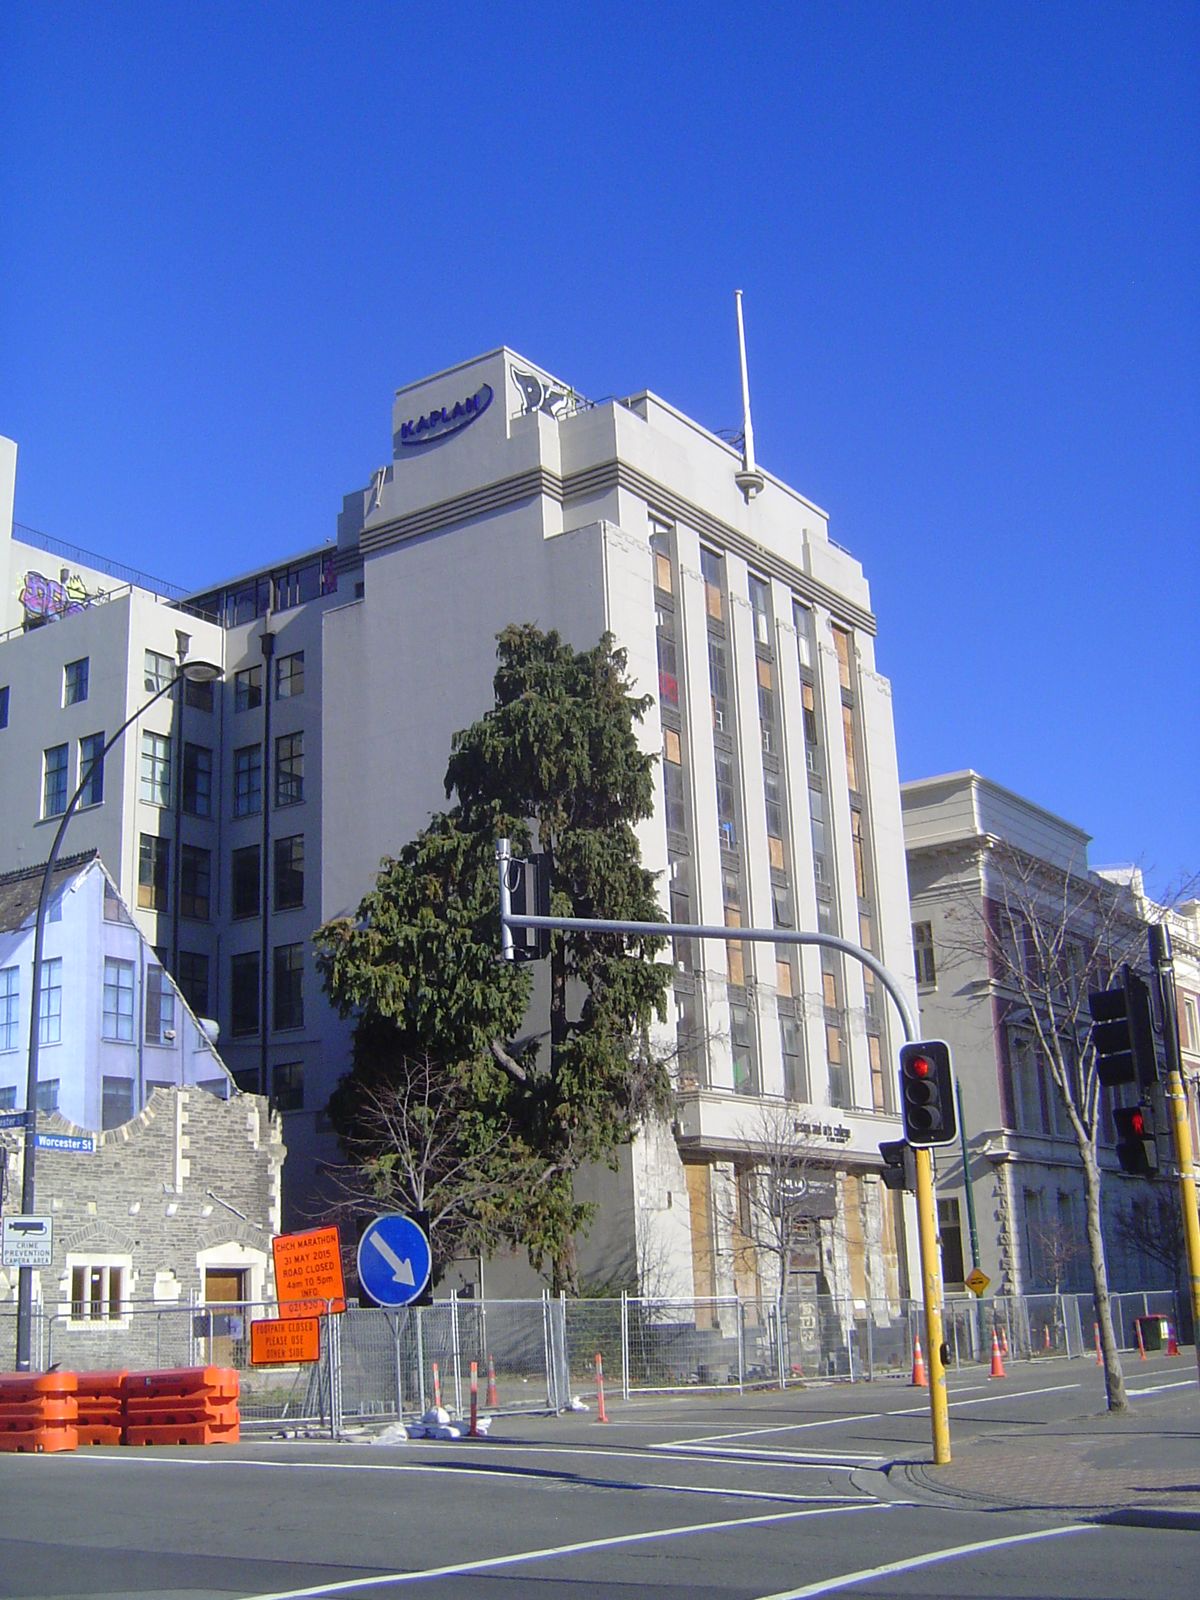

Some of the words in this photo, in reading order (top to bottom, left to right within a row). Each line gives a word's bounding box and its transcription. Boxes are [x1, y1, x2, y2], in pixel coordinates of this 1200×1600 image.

[401, 394, 480, 438] KAPLAN
[39, 1135, 81, 1149] Worcester
[82, 1140, 92, 1150] St
[276, 1242, 295, 1253] CHCH
[297, 1234, 336, 1249] MARATHON
[284, 1257, 292, 1266] 31
[294, 1254, 310, 1264] MAY
[313, 1249, 331, 1261] 2015
[283, 1267, 303, 1278] ROAD
[305, 1261, 335, 1274] CLOSED
[286, 1281, 303, 1289] 4am
[305, 1277, 314, 1286] TO
[256, 1324, 285, 1335] FOOTPATH
[288, 1321, 313, 1333] CLOSED
[265, 1336, 288, 1346] PLEASE
[290, 1335, 304, 1345] USE
[266, 1349, 286, 1359] OTHER
[289, 1347, 304, 1358] SIDE
